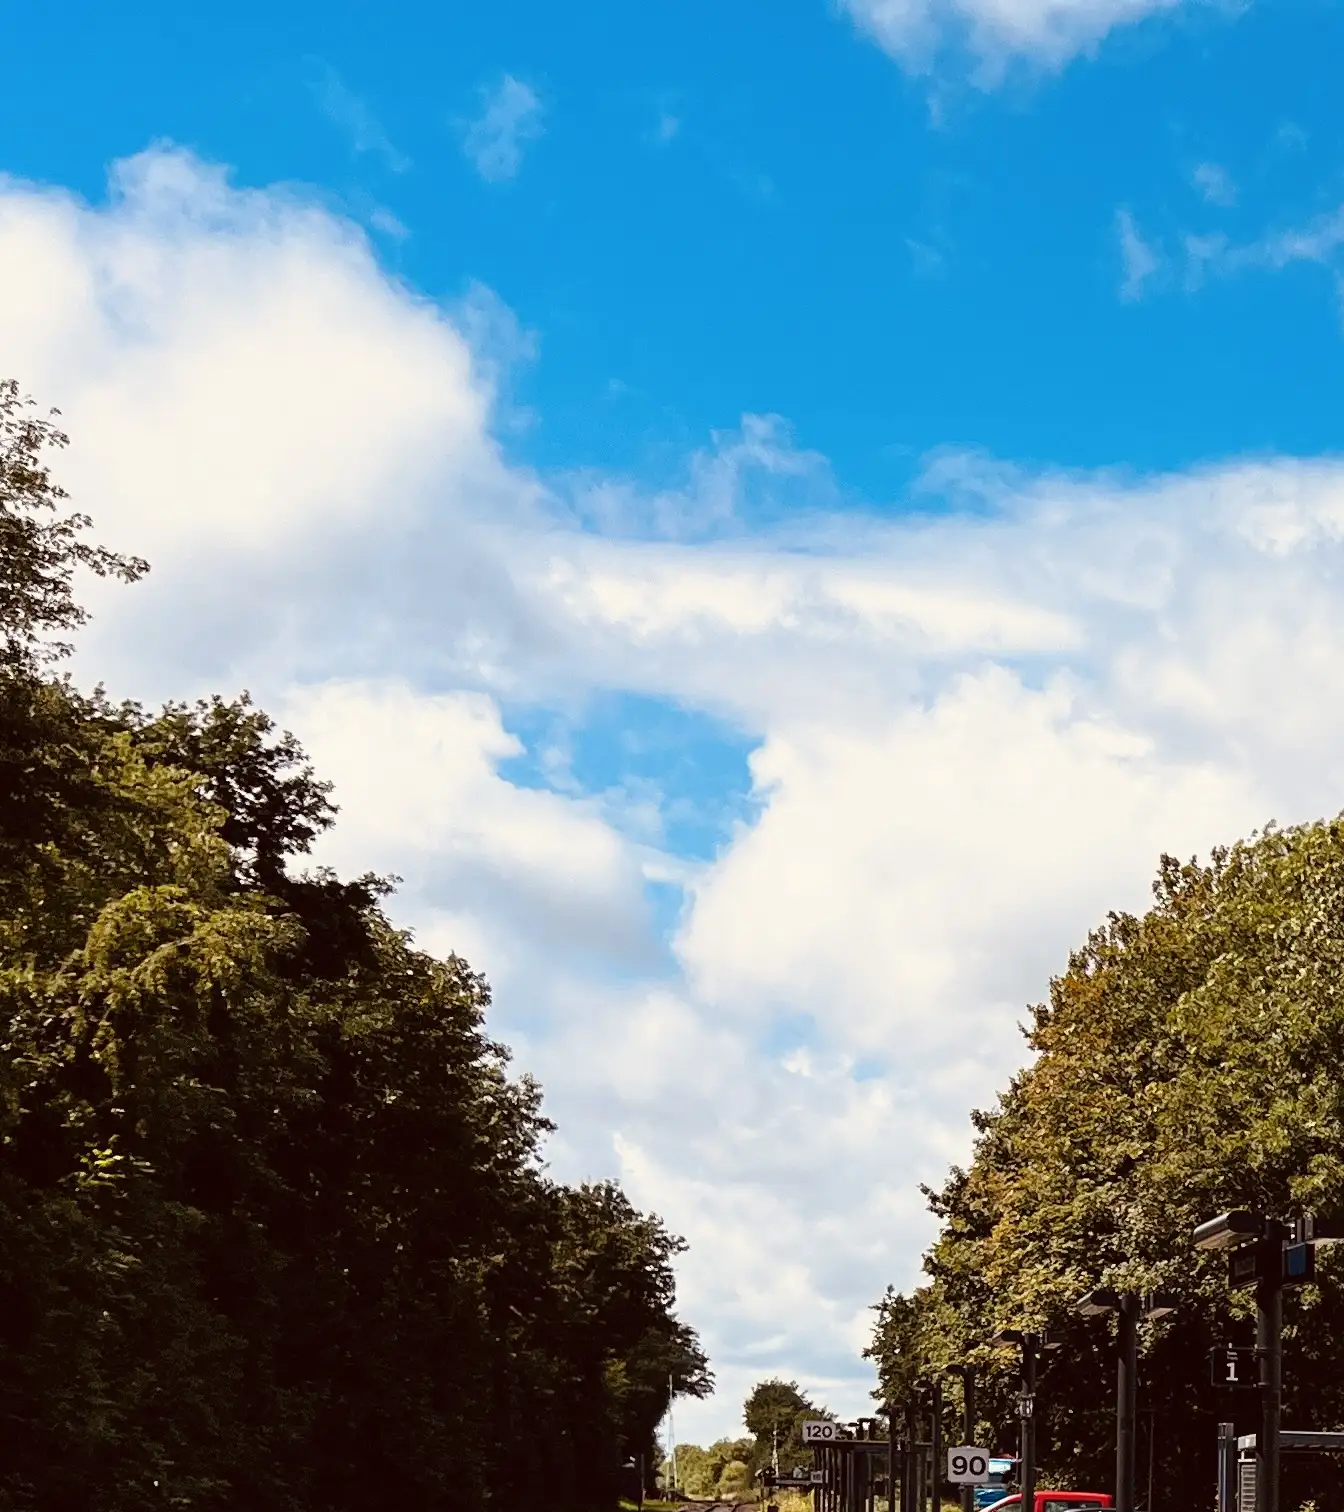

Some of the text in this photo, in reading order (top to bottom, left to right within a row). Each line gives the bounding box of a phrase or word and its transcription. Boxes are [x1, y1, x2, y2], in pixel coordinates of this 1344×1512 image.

[1226, 1362, 1239, 1381] 1
[805, 1425, 833, 1438] 120
[952, 1455, 986, 1476] 90
